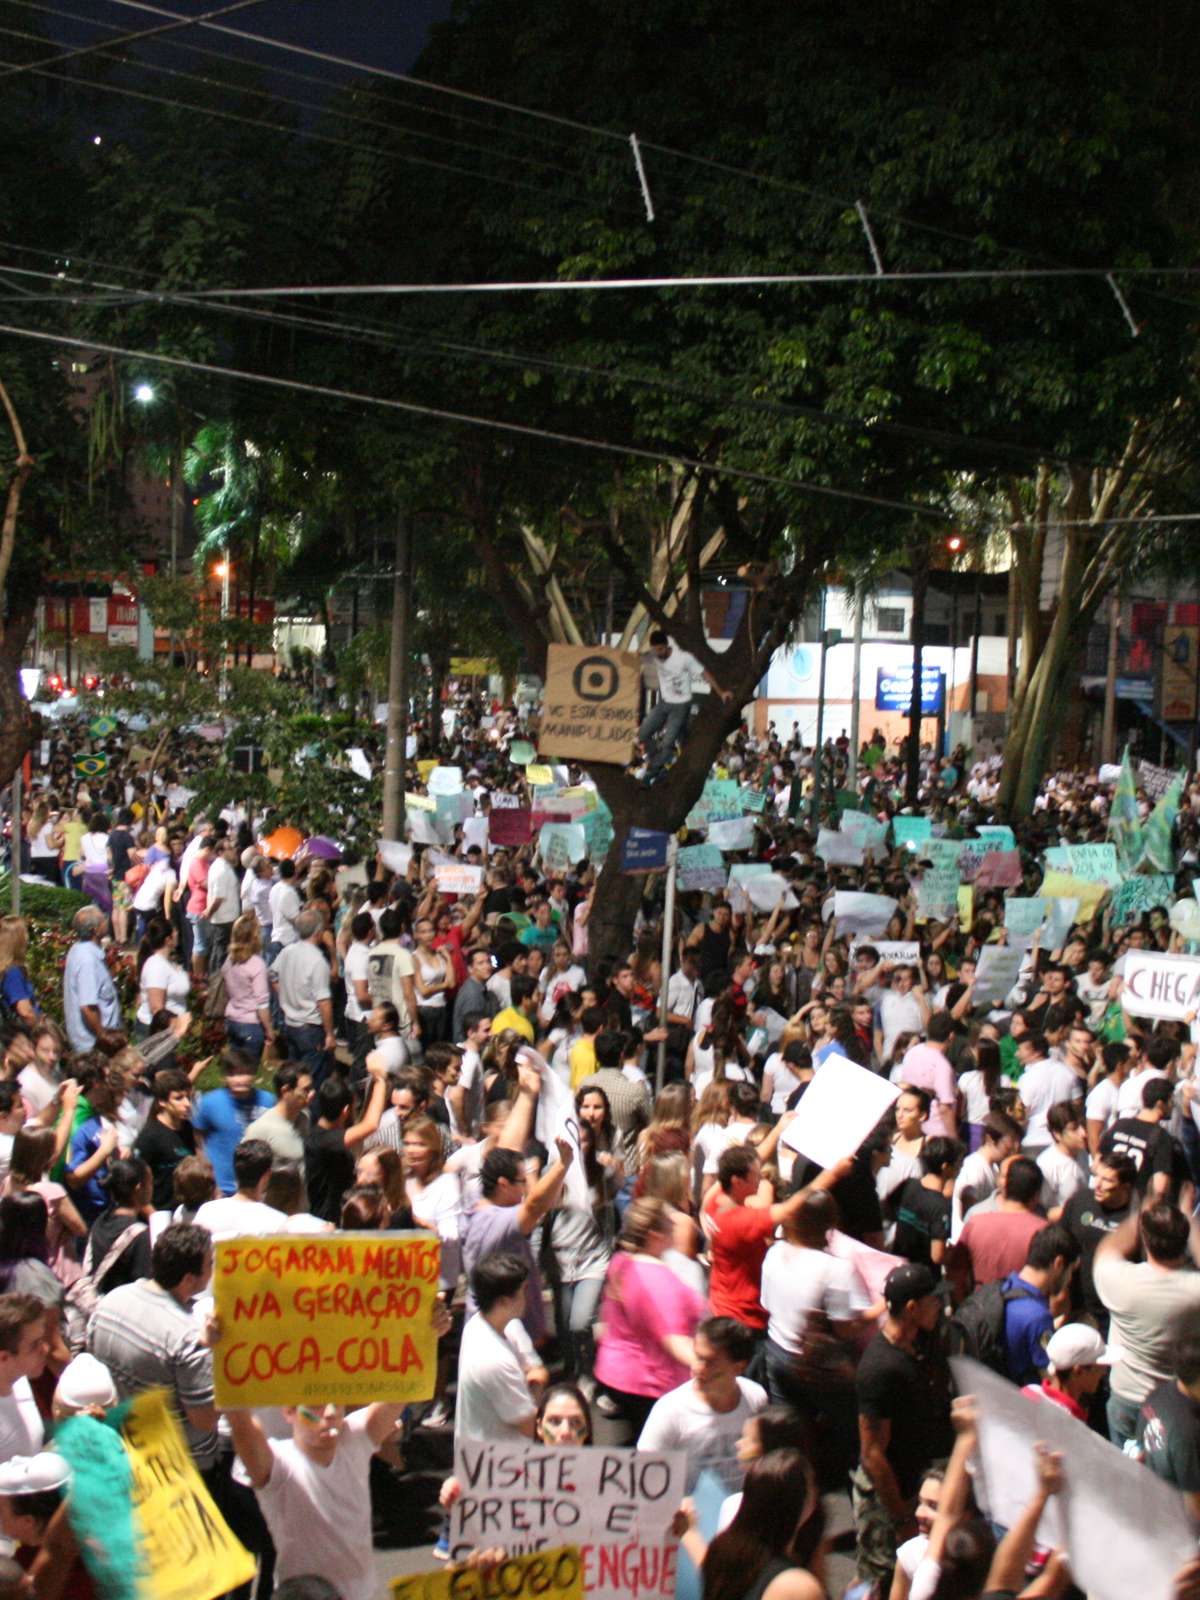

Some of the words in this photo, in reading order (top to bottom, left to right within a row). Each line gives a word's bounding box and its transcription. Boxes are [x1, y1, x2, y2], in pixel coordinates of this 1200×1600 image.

[222, 1244, 356, 1280] JOGARAM
[361, 1240, 442, 1284] MENTOS
[233, 1290, 282, 1322] NA
[292, 1282, 422, 1330] GERAÇÃO
[223, 1334, 424, 1387] COCA-COLA
[456, 1497, 581, 1536] PRETO
[606, 1504, 639, 1533] E
[449, 1552, 579, 1600] GLOBO
[579, 1543, 680, 1599] ENGUE
